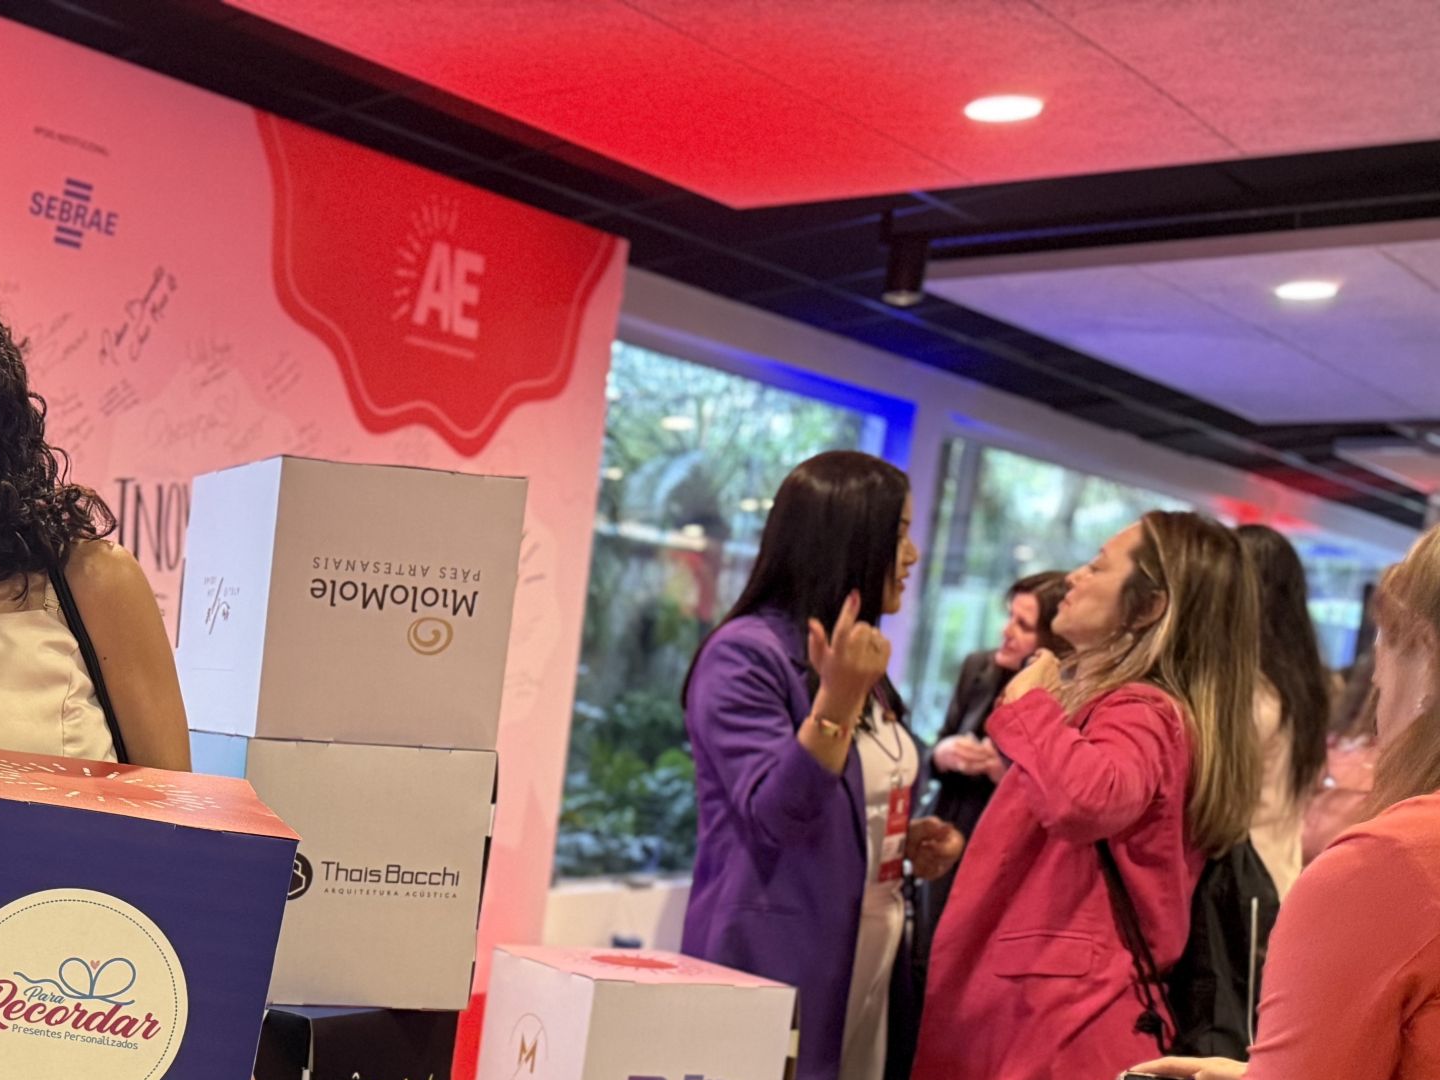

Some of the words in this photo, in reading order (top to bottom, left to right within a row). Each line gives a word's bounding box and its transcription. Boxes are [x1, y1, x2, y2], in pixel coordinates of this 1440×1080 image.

[29, 190, 119, 237] SEBRAE
[311, 555, 431, 578] ARTESANAIS
[438, 565, 482, 582] PÃES
[323, 887, 400, 897] ARQUITETURA
[404, 888, 458, 899] ACÚSTICA
[23, 985, 66, 1005] Para
[11, 1023, 63, 1040] Presentes
[63, 1031, 139, 1051] Personalizados
